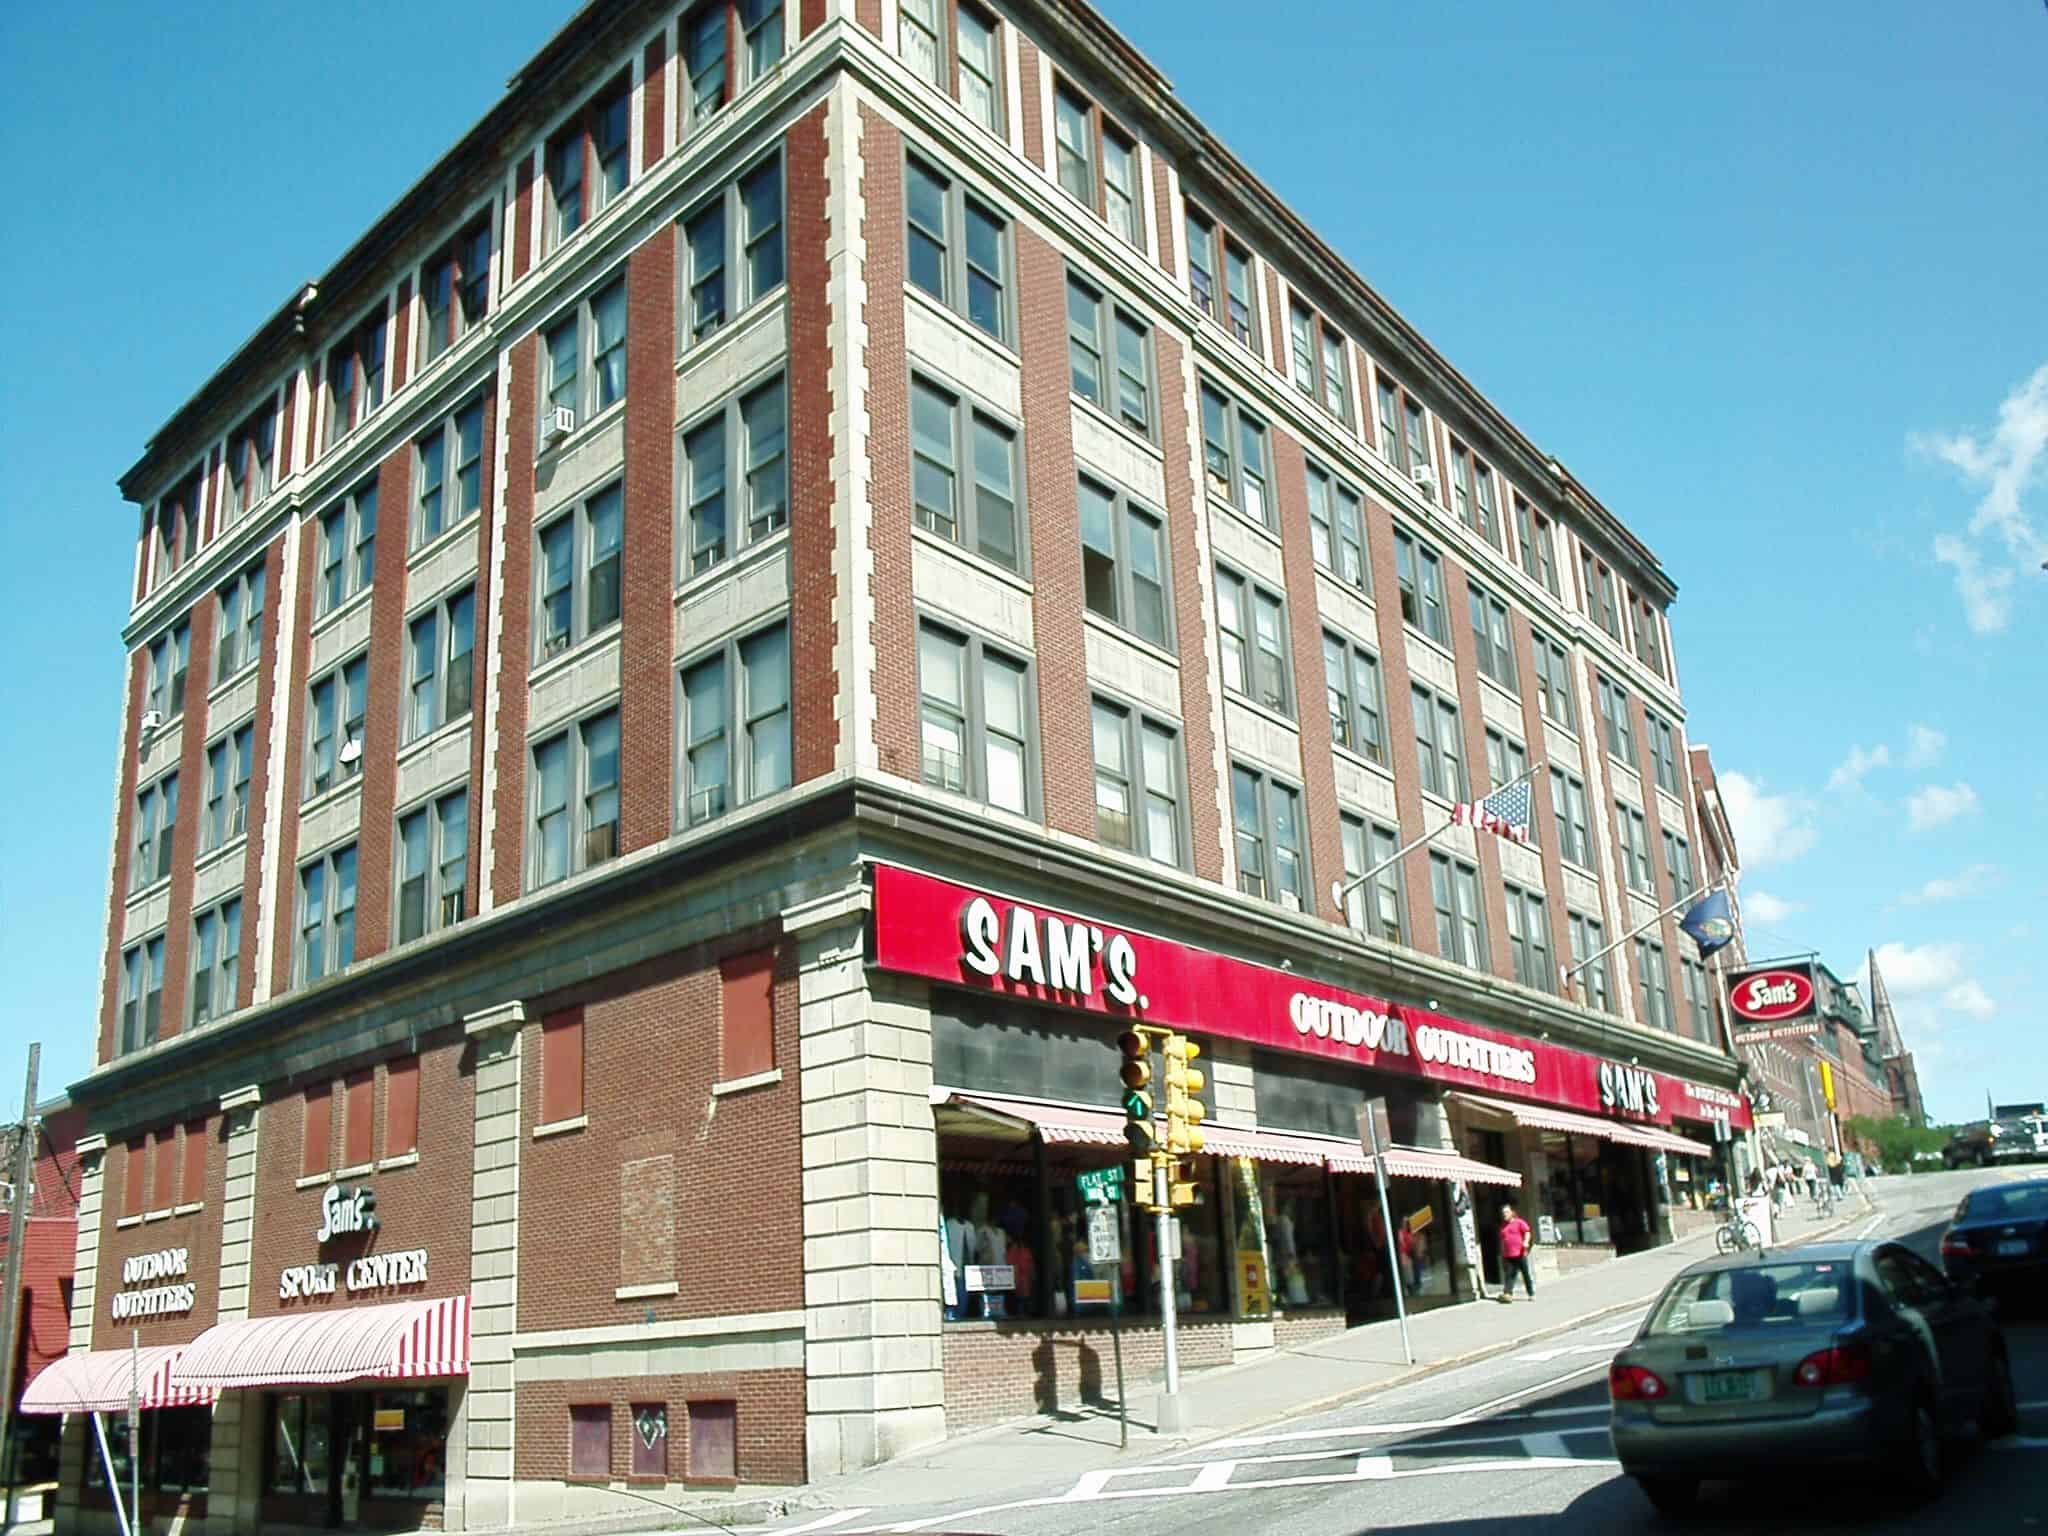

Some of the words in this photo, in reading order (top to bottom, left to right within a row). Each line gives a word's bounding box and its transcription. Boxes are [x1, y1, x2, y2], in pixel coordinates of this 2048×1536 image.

[1746, 979, 1797, 1011] Sam's
[1290, 992, 1410, 1056] OUTDOOR
[1416, 1025, 1536, 1084] OUTFITTERS
[1081, 1172, 1102, 1189] FLAT
[1107, 1168, 1118, 1182] ST
[123, 1248, 188, 1284] OUTDOOR
[279, 1263, 339, 1299] SPORT
[346, 1249, 428, 1292] CENTER
[112, 1282, 196, 1319] OUTFITTERS
